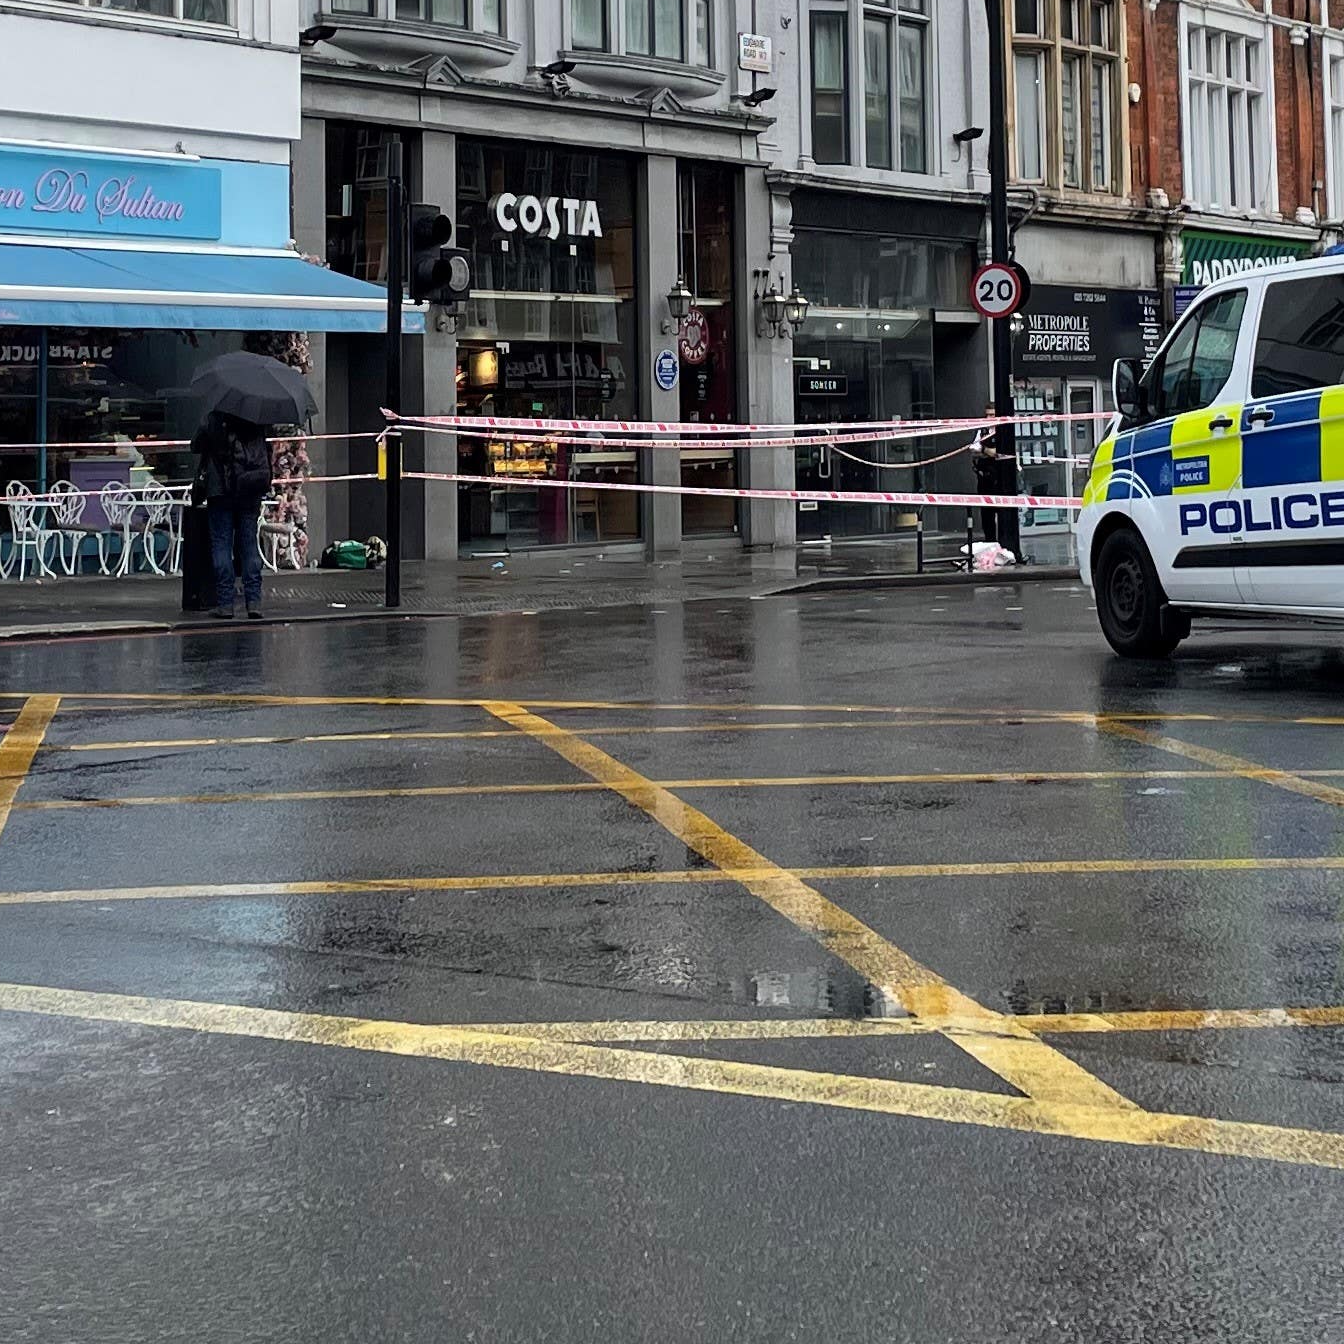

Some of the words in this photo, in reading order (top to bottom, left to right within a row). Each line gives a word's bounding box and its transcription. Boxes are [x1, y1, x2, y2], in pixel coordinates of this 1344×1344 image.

[32, 168, 88, 214] Du
[97, 174, 185, 224] Sultan
[494, 192, 603, 240] COSTA
[979, 279, 1014, 302] 20
[1028, 314, 1089, 331] METROPOLE
[1028, 334, 1090, 352] PROPERTIES
[1180, 471, 1204, 483] POLICE
